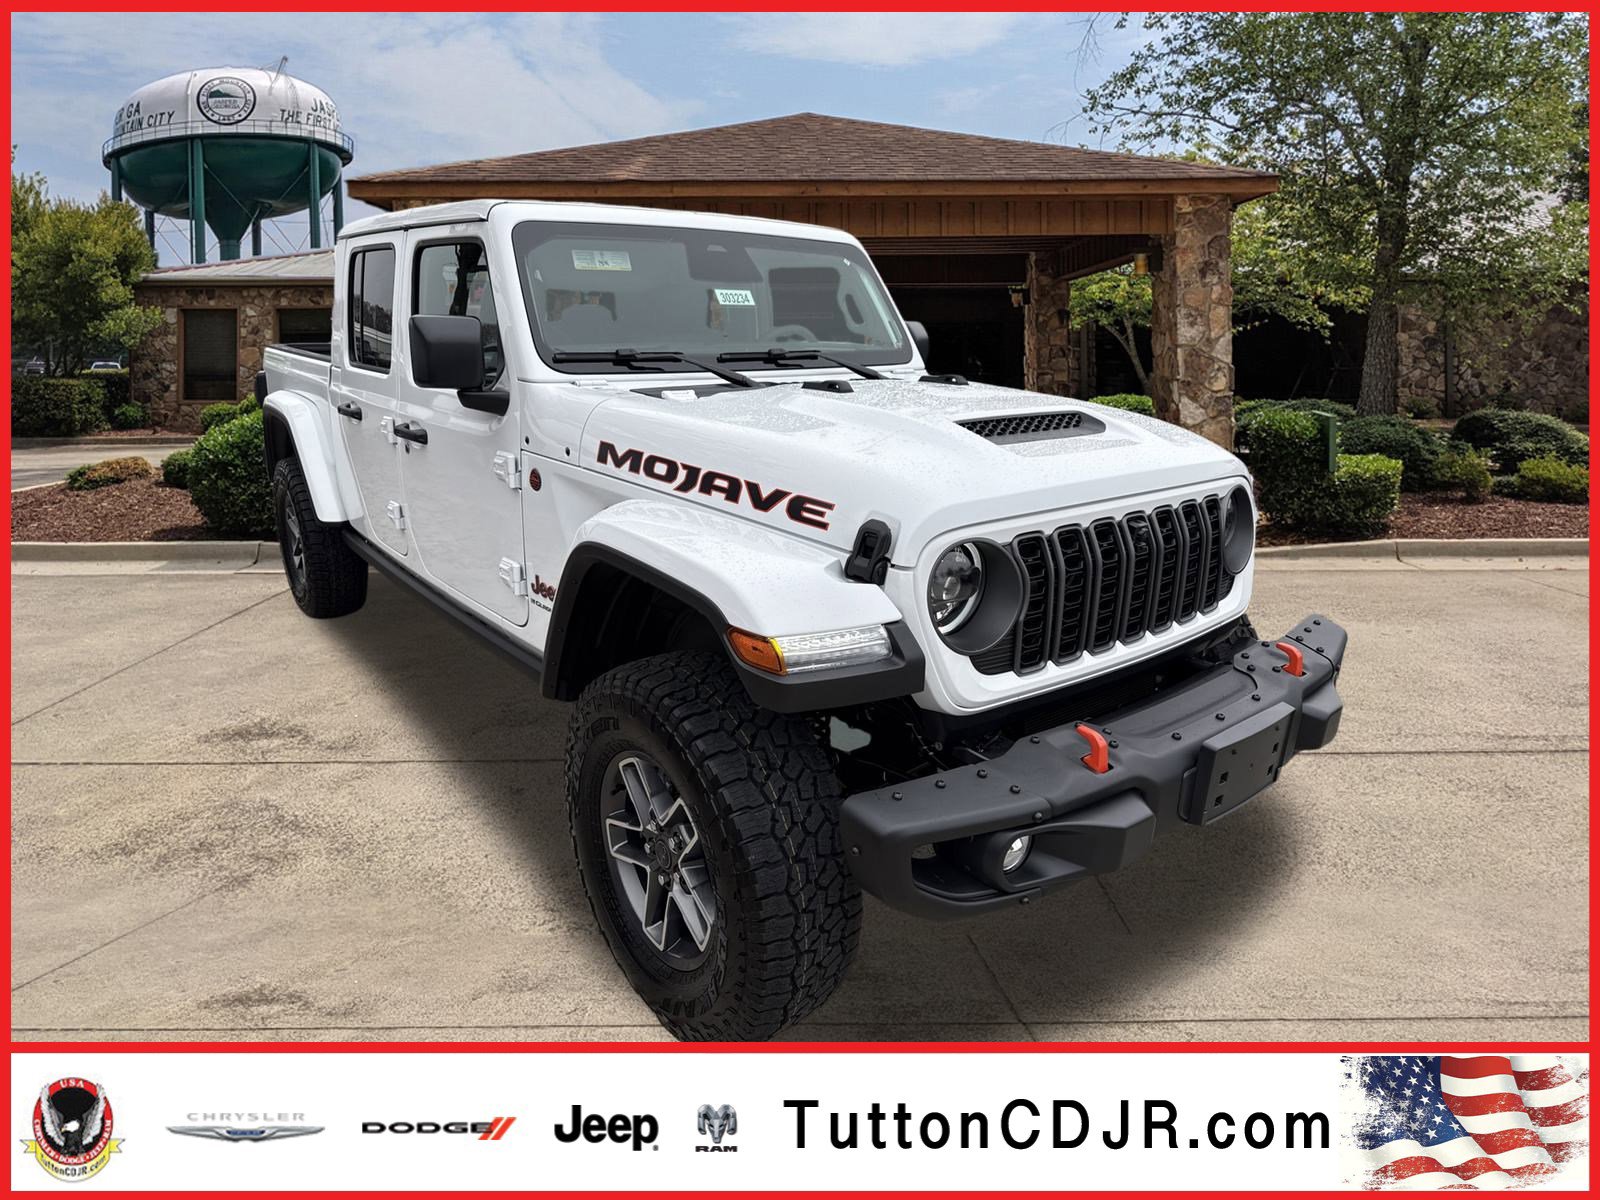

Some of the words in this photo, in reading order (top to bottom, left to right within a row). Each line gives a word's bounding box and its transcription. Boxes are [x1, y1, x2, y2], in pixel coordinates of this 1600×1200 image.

[126, 101, 141, 119] GA
[147, 110, 175, 127] CITY
[280, 108, 303, 124] THE
[306, 112, 332, 129] FIRST
[719, 292, 751, 304] 303234
[596, 439, 836, 532] MOJAVE
[530, 574, 557, 602] Jee
